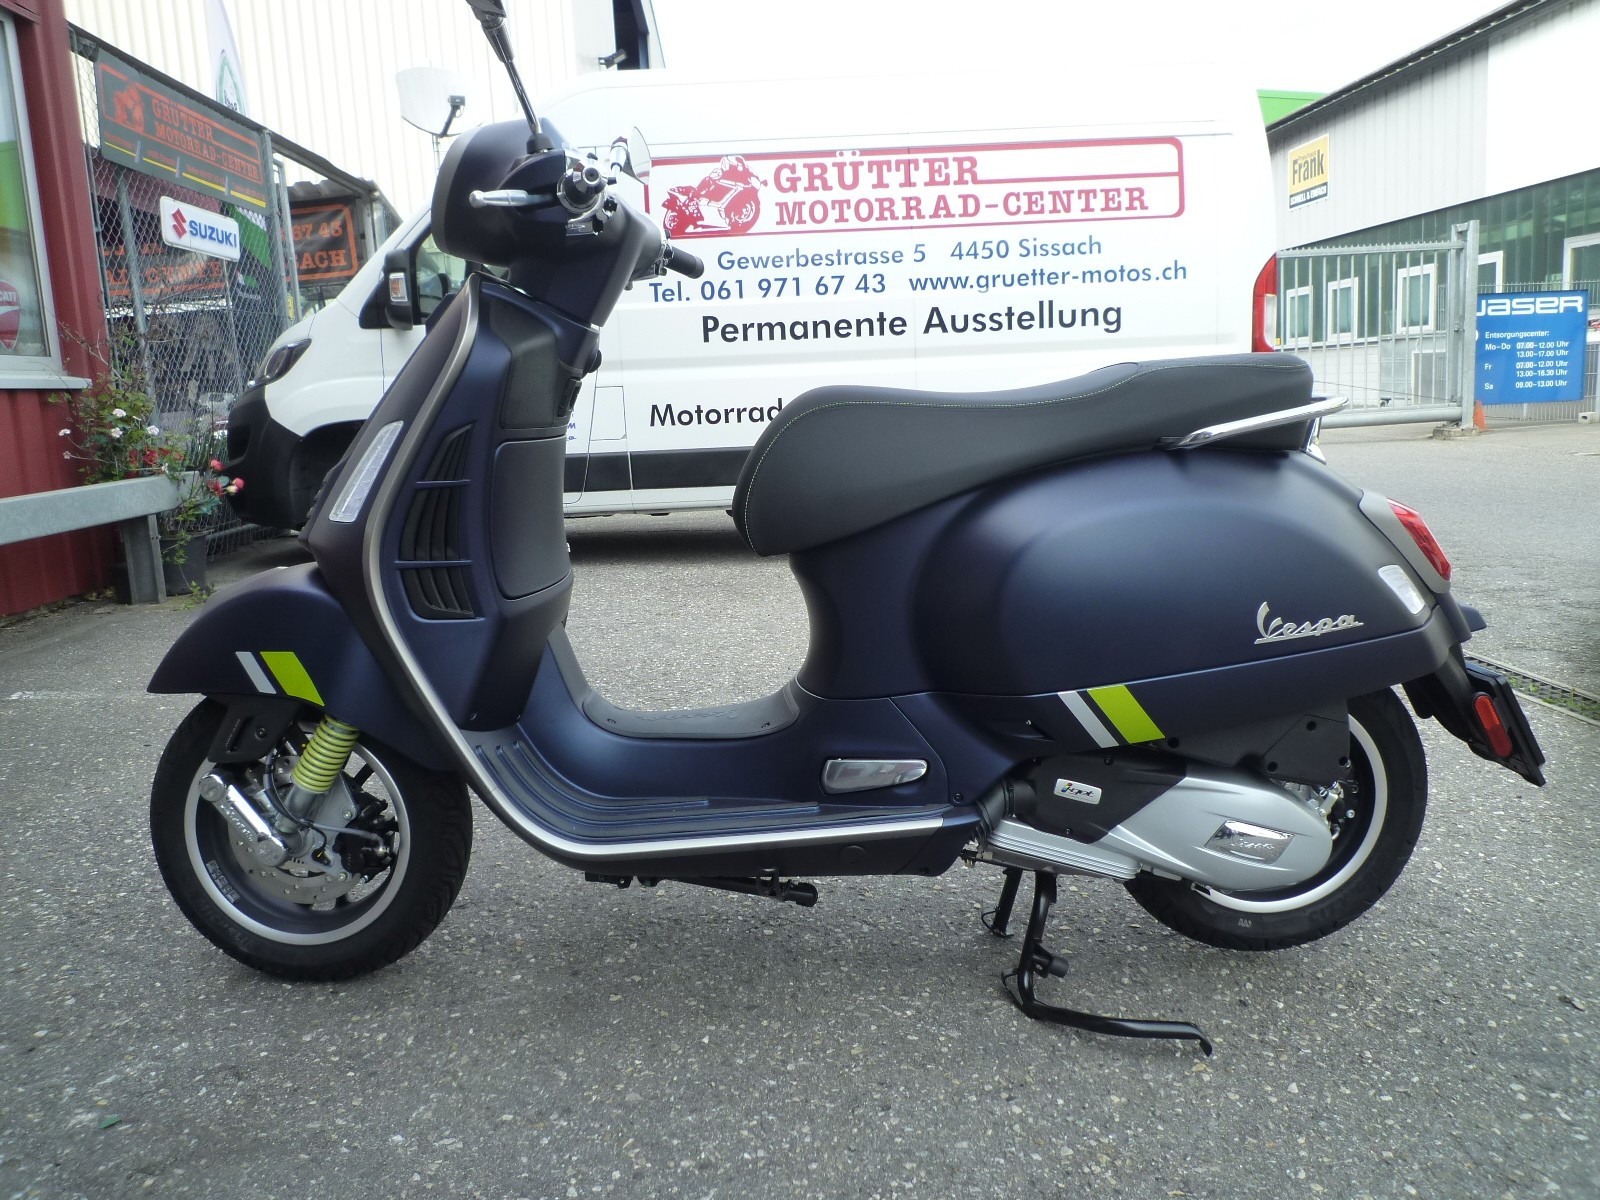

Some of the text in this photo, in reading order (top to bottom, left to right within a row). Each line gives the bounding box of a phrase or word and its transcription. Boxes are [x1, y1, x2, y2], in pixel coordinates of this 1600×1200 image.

[153, 98, 213, 141] GRÜTTER
[155, 121, 258, 177] MOTORRAD-CENTER
[1292, 149, 1325, 185] Frank
[773, 150, 979, 194] GRÜTTER
[775, 186, 1149, 226] MOTORRAD-CENTER
[188, 218, 238, 249] SUZUKI
[717, 234, 1103, 271] Gewerbestrasse 5 4450 Sissach
[649, 259, 1188, 303] Tel. 061 971 67 43 www.gruetter-motos.ch
[702, 299, 1123, 343] Permanente Ausstellung
[1485, 331, 1550, 340] Entsorgungscenter:
[1556, 340, 1569, 348] Uhr
[1556, 349, 1569, 357] Uhr
[1484, 363, 1493, 371] Fr
[1555, 359, 1569, 368] Uhr
[1555, 368, 1569, 376] Uhr
[1484, 382, 1494, 391] Sa
[1554, 379, 1568, 387] Uhr
[650, 398, 783, 427] Motorrad
[1254, 601, 1364, 645] Vespa
